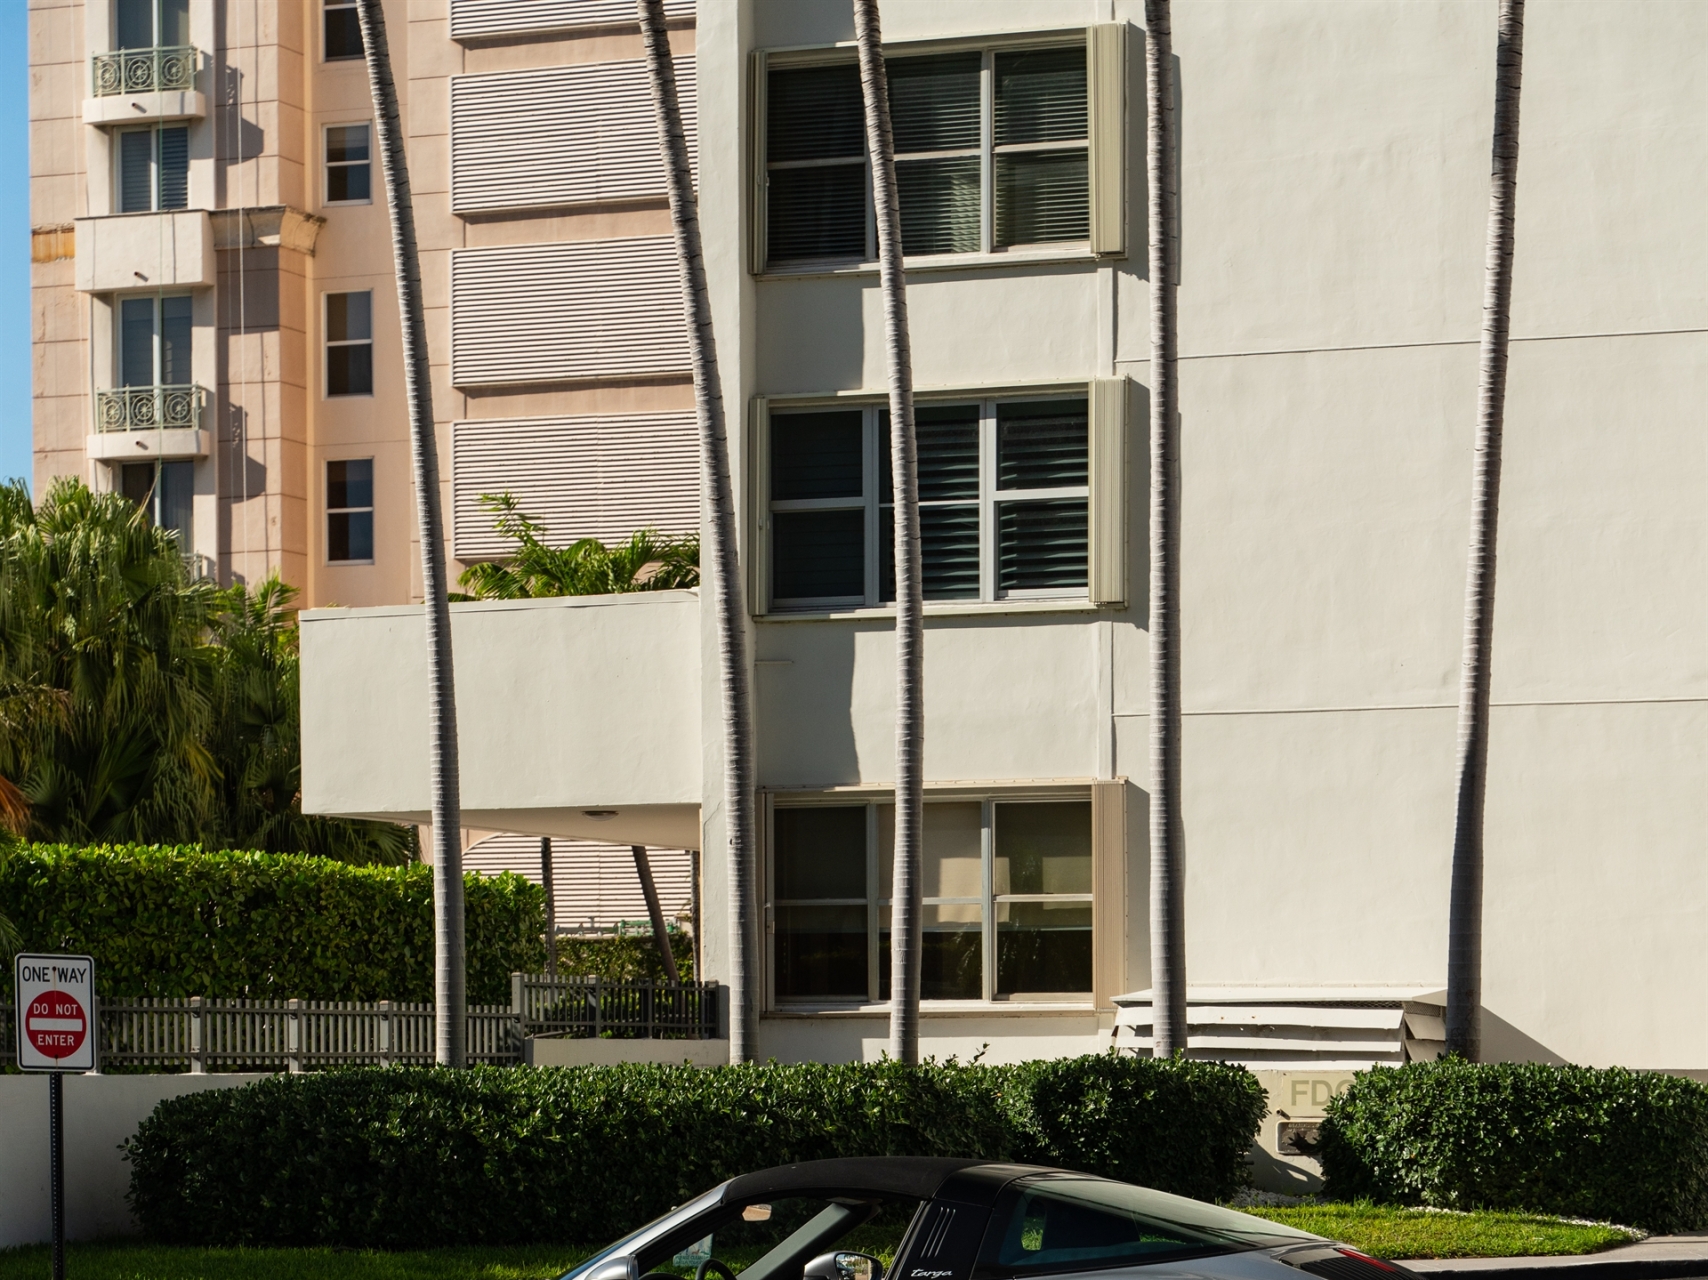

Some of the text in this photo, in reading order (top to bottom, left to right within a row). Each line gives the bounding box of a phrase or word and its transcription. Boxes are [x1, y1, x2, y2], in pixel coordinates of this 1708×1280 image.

[22, 966, 87, 983] ONE WAY
[33, 1003, 78, 1016] DO NOT
[37, 1034, 75, 1047] ENTER
[911, 1268, 953, 1279] targa
